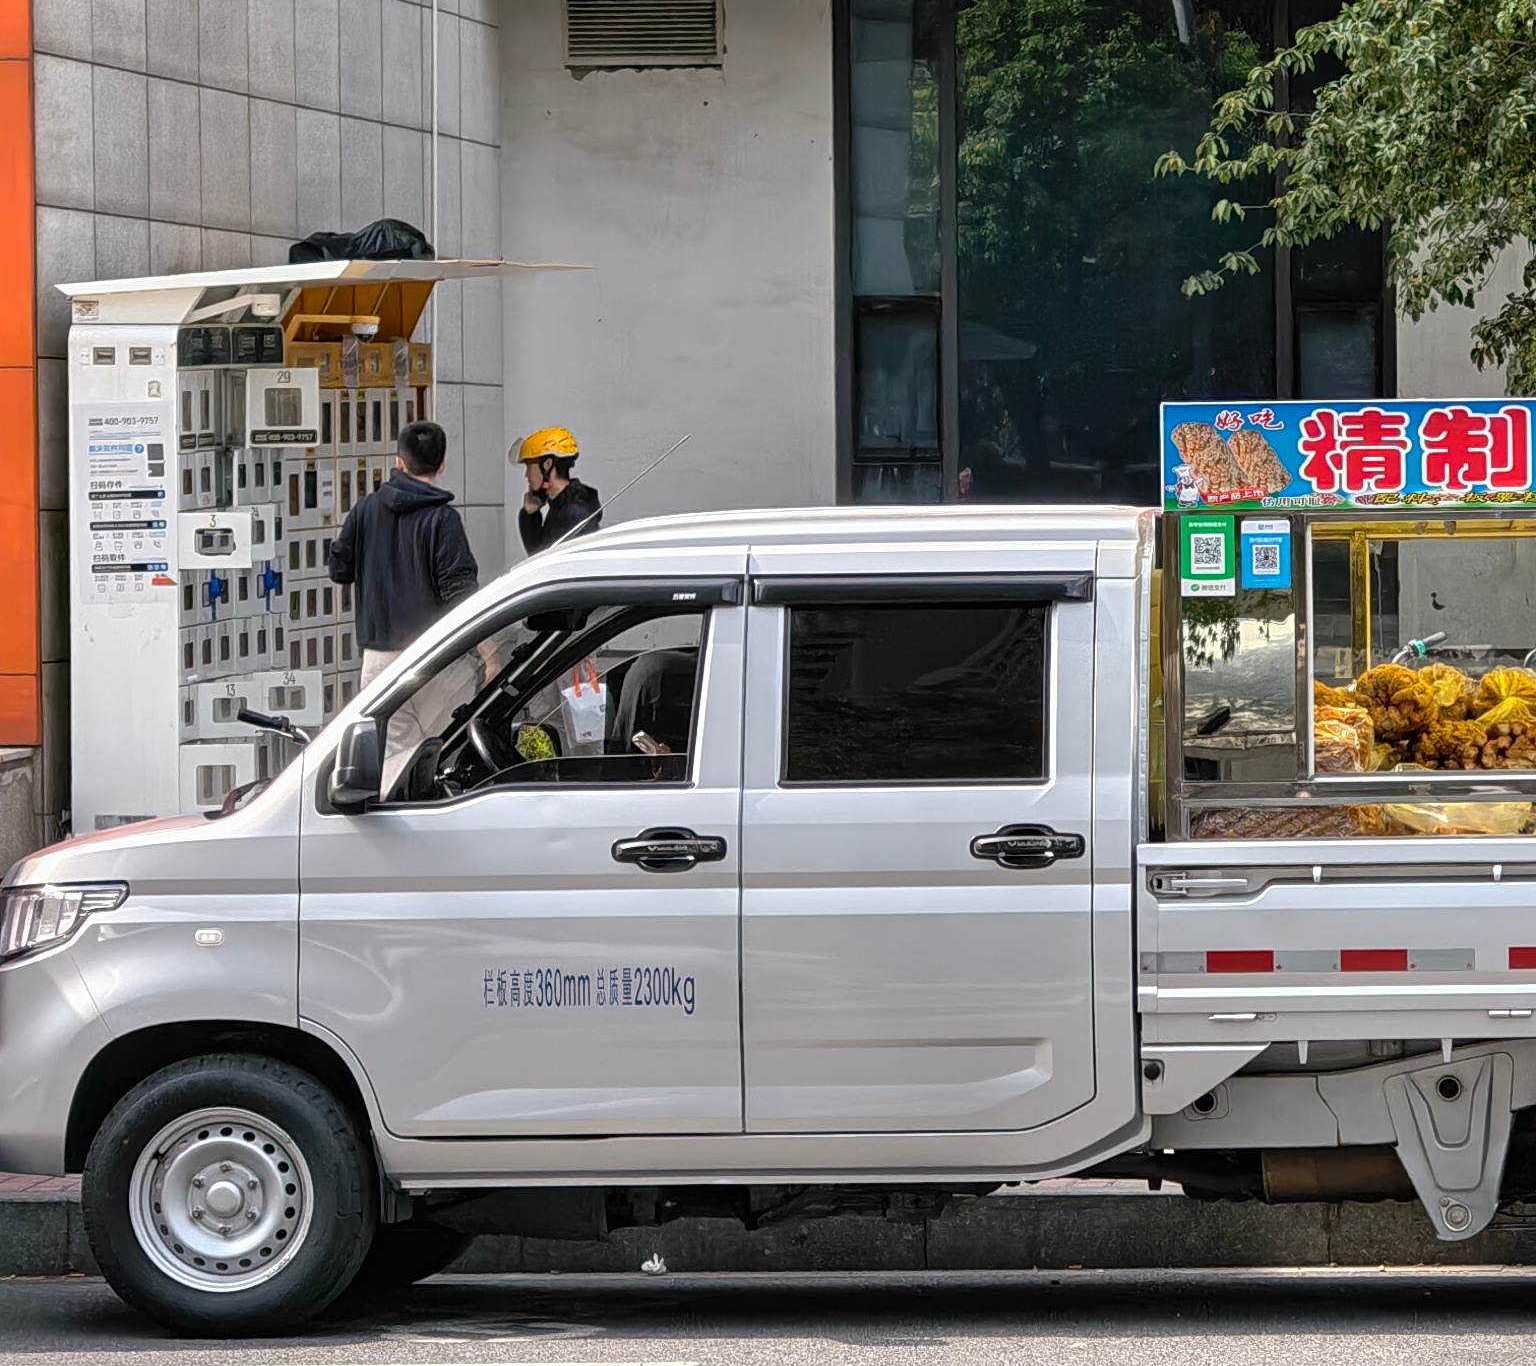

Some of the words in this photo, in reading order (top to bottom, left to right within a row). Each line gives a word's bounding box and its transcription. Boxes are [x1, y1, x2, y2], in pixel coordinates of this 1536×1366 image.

[277, 370, 291, 384] 29
[1215, 408, 1284, 430] 好吃
[209, 514, 217, 528] 3
[282, 672, 296, 685] 34
[225, 683, 236, 697] 13
[484, 968, 591, 1007] 栏板高度360mm
[596, 967, 696, 1015] 总质量2300kg
